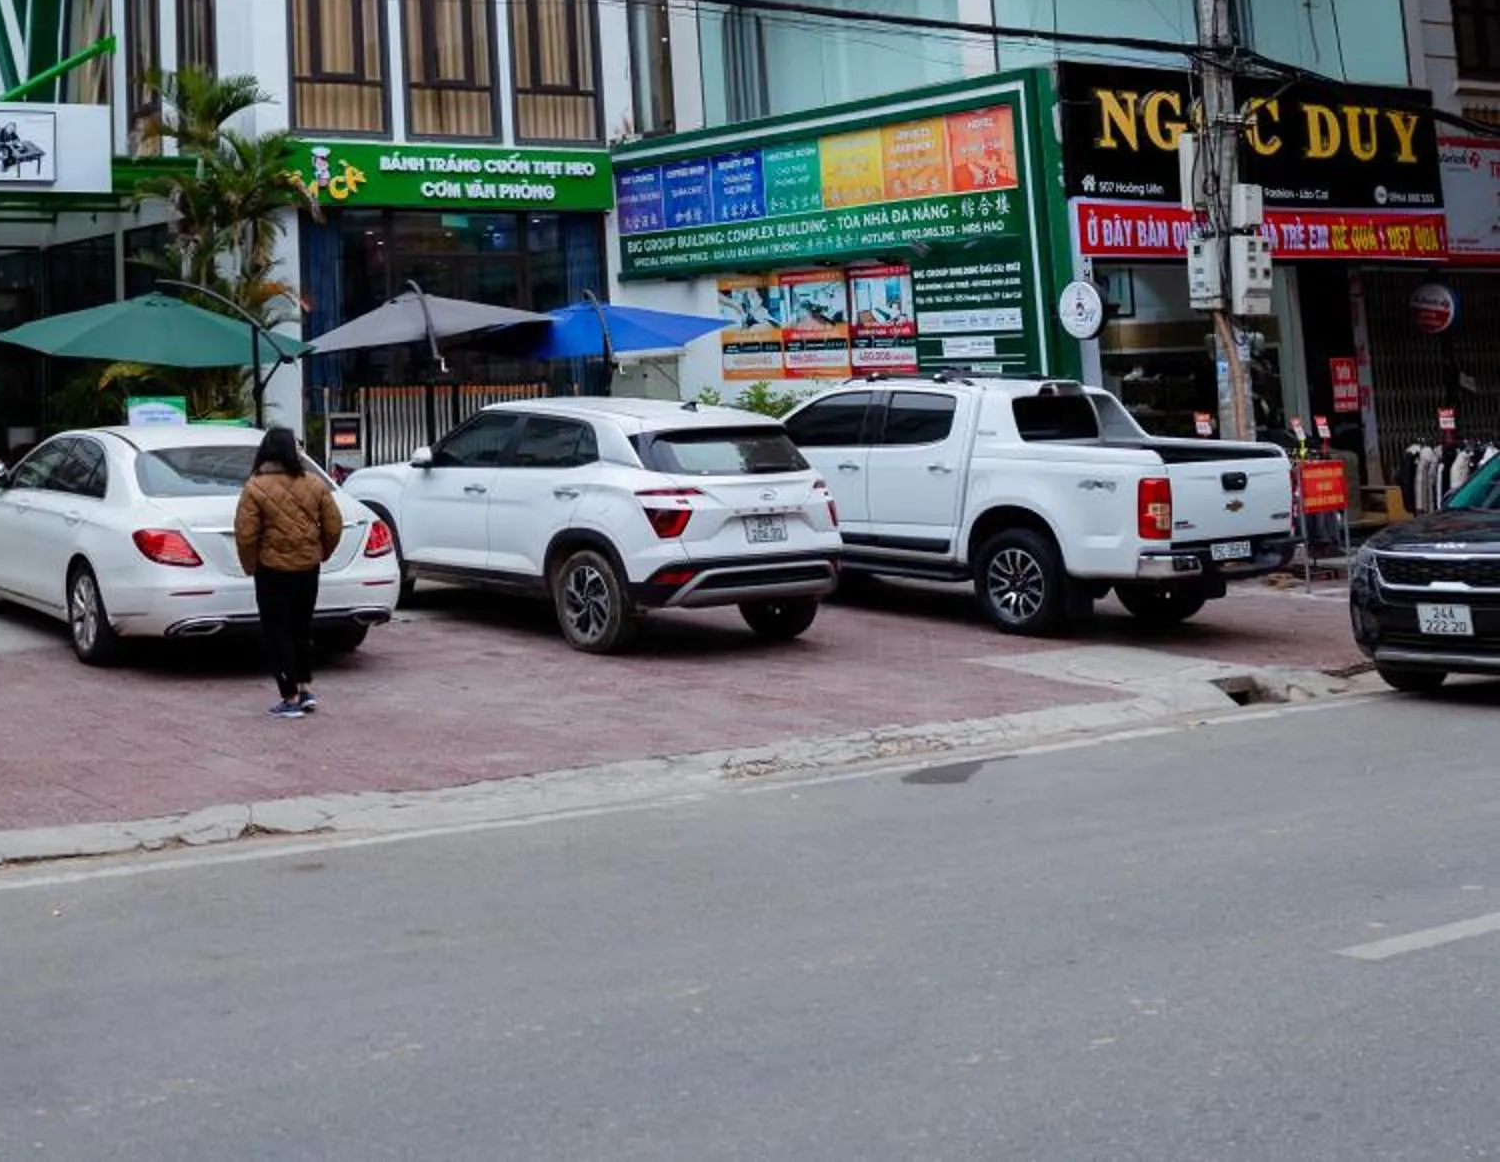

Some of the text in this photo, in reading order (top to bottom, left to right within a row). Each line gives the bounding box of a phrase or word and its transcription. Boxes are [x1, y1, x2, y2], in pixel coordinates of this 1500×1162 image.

[1096, 89, 1419, 164] NGC DUY
[565, 162, 596, 176] HEO
[499, 178, 556, 200] PHÒNG
[777, 219, 828, 237] BUILDING
[1102, 213, 1132, 246] ĐÂY
